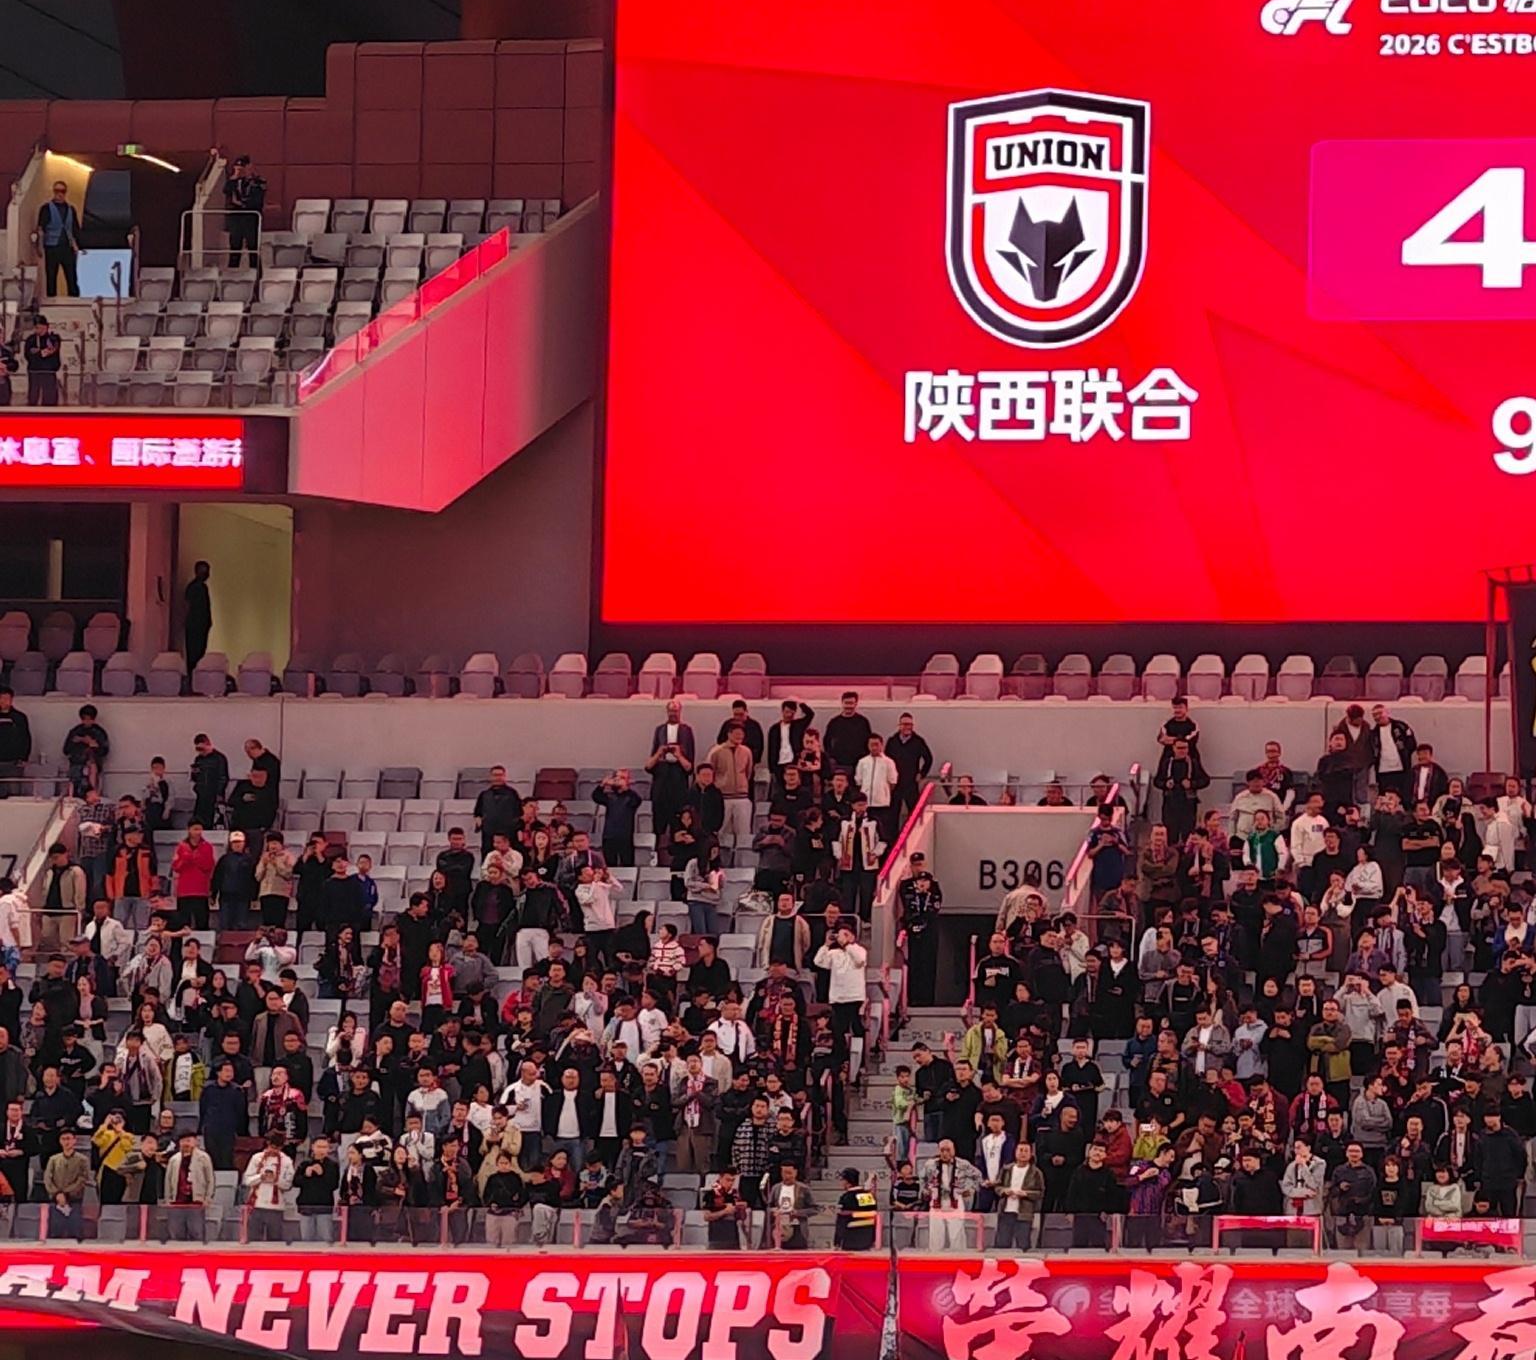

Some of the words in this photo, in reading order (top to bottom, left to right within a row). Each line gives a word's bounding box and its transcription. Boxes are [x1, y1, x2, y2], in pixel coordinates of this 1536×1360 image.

[1379, 33, 1441, 56] 2026
[991, 138, 1106, 171] UNION
[904, 367, 1199, 443] 陕西联合
[979, 859, 1065, 890] B306
[168, 1266, 491, 1357] NEVER
